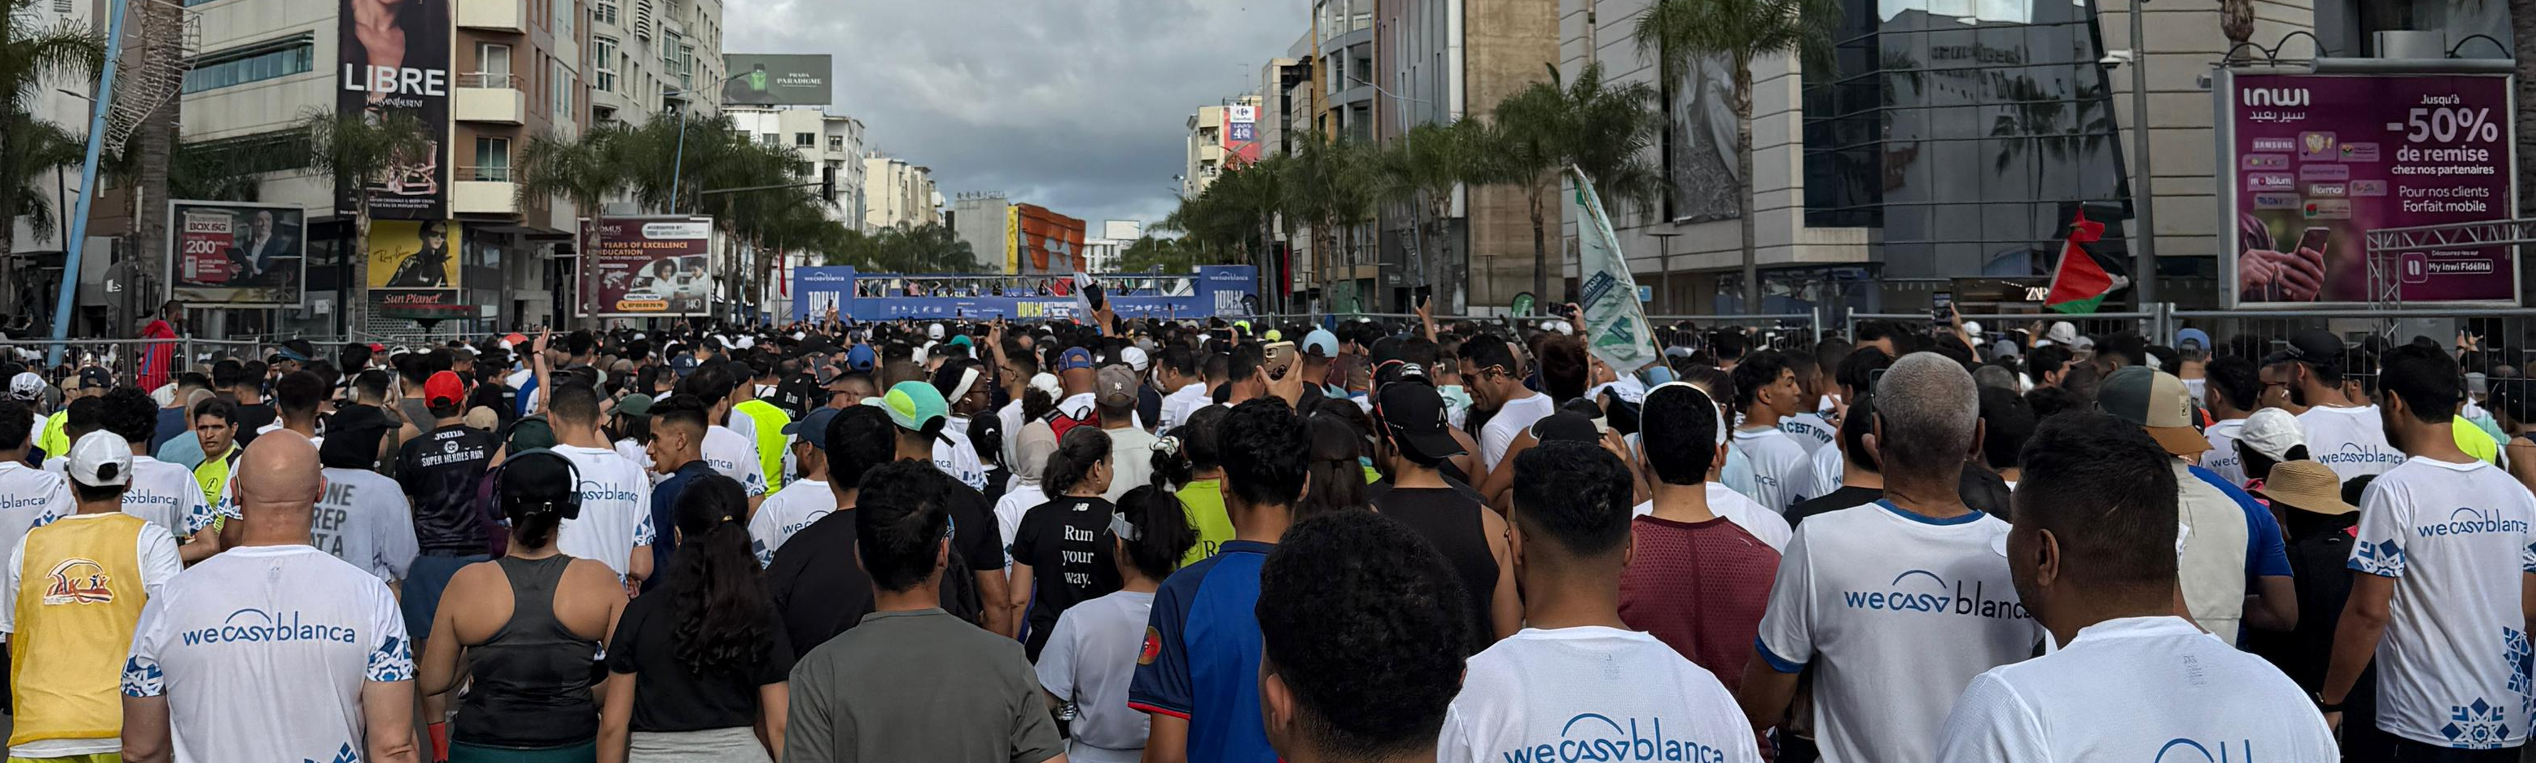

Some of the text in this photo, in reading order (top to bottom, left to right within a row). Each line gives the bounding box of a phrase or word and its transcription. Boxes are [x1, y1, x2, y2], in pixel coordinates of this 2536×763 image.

[345, 63, 446, 97] LIBRE
[2420, 94, 2460, 106] Jusqu'à
[2386, 107, 2498, 143] -50%
[2254, 140, 2293, 150] SAMSUNG
[2396, 145, 2420, 161] de
[2424, 145, 2489, 161] remise
[2391, 164, 2495, 176] chez nos partenaires
[2399, 185, 2490, 197] Pour nos clients
[2403, 200, 2487, 212] Forfait mobile
[189, 222, 210, 231] BOX
[186, 240, 216, 254] 200
[630, 242, 641, 250] OF
[2428, 262, 2441, 273] My
[384, 293, 441, 304] Sun Planet
[1064, 525, 1094, 542] Run
[1062, 550, 1094, 567] your
[1064, 572, 1091, 589] way.
